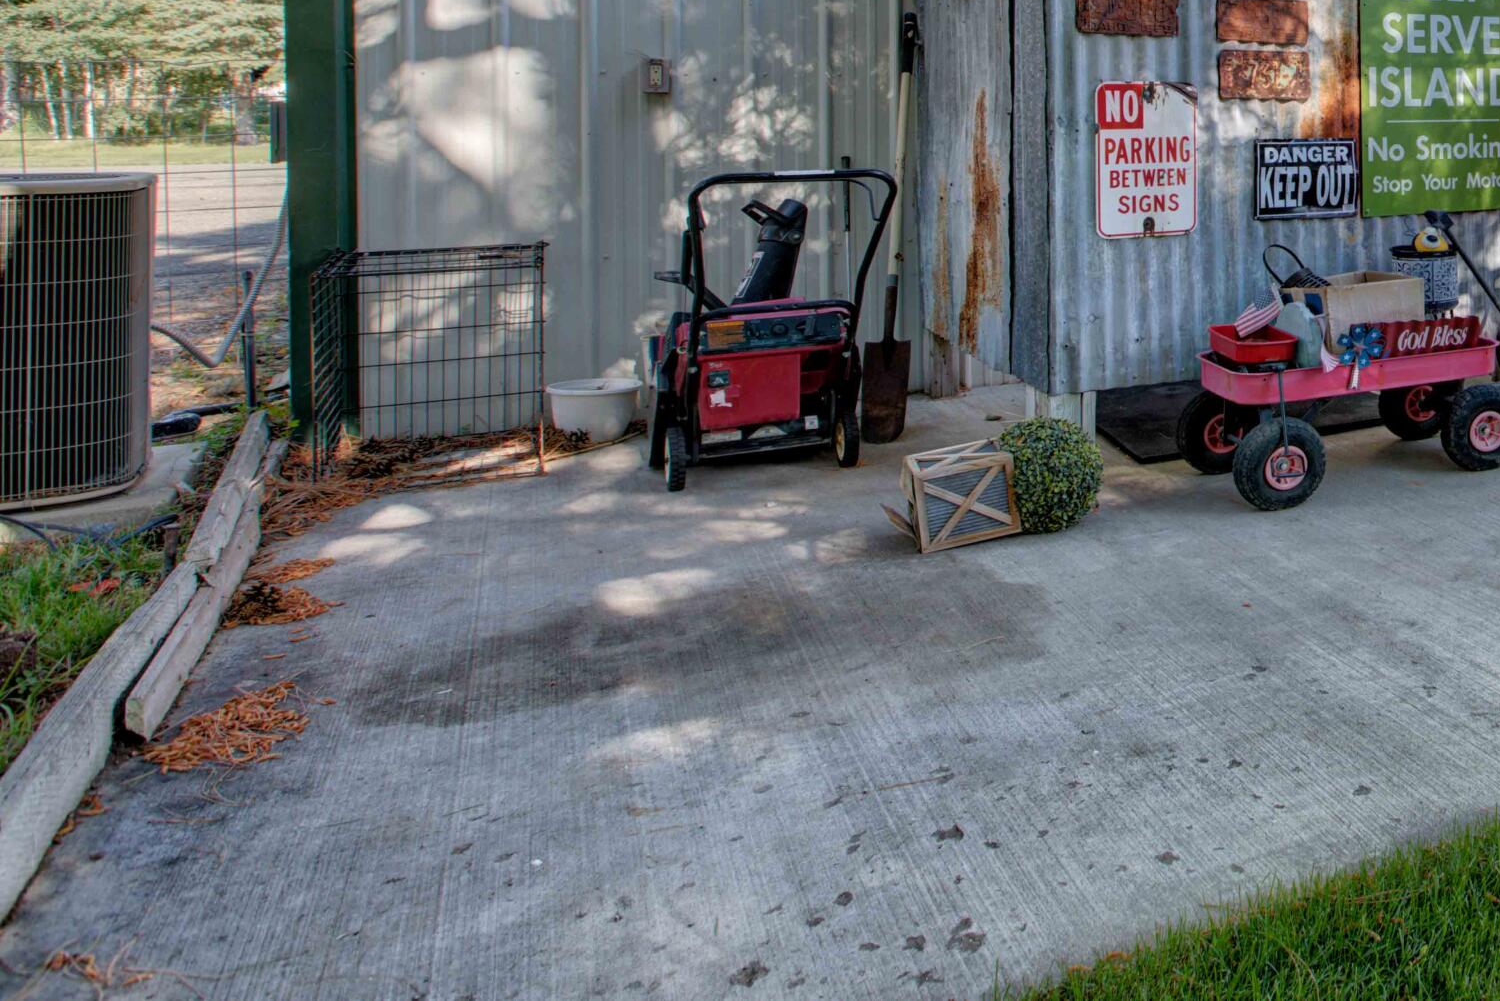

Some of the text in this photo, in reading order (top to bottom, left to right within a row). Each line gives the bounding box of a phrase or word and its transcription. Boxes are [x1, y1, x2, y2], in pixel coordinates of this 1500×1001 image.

[1382, 12, 1500, 55] SERVE
[1105, 89, 1139, 123] NO
[1104, 136, 1190, 165] PARKING
[1264, 146, 1349, 164] DANGER
[1367, 136, 1405, 162] No
[1109, 168, 1186, 188] BETWEEN
[1260, 165, 1354, 208] KEEP OUT
[1372, 174, 1413, 195] Stop
[1421, 173, 1458, 191] Your
[1117, 193, 1179, 214] SIGNS
[1397, 325, 1469, 351] God Bless
